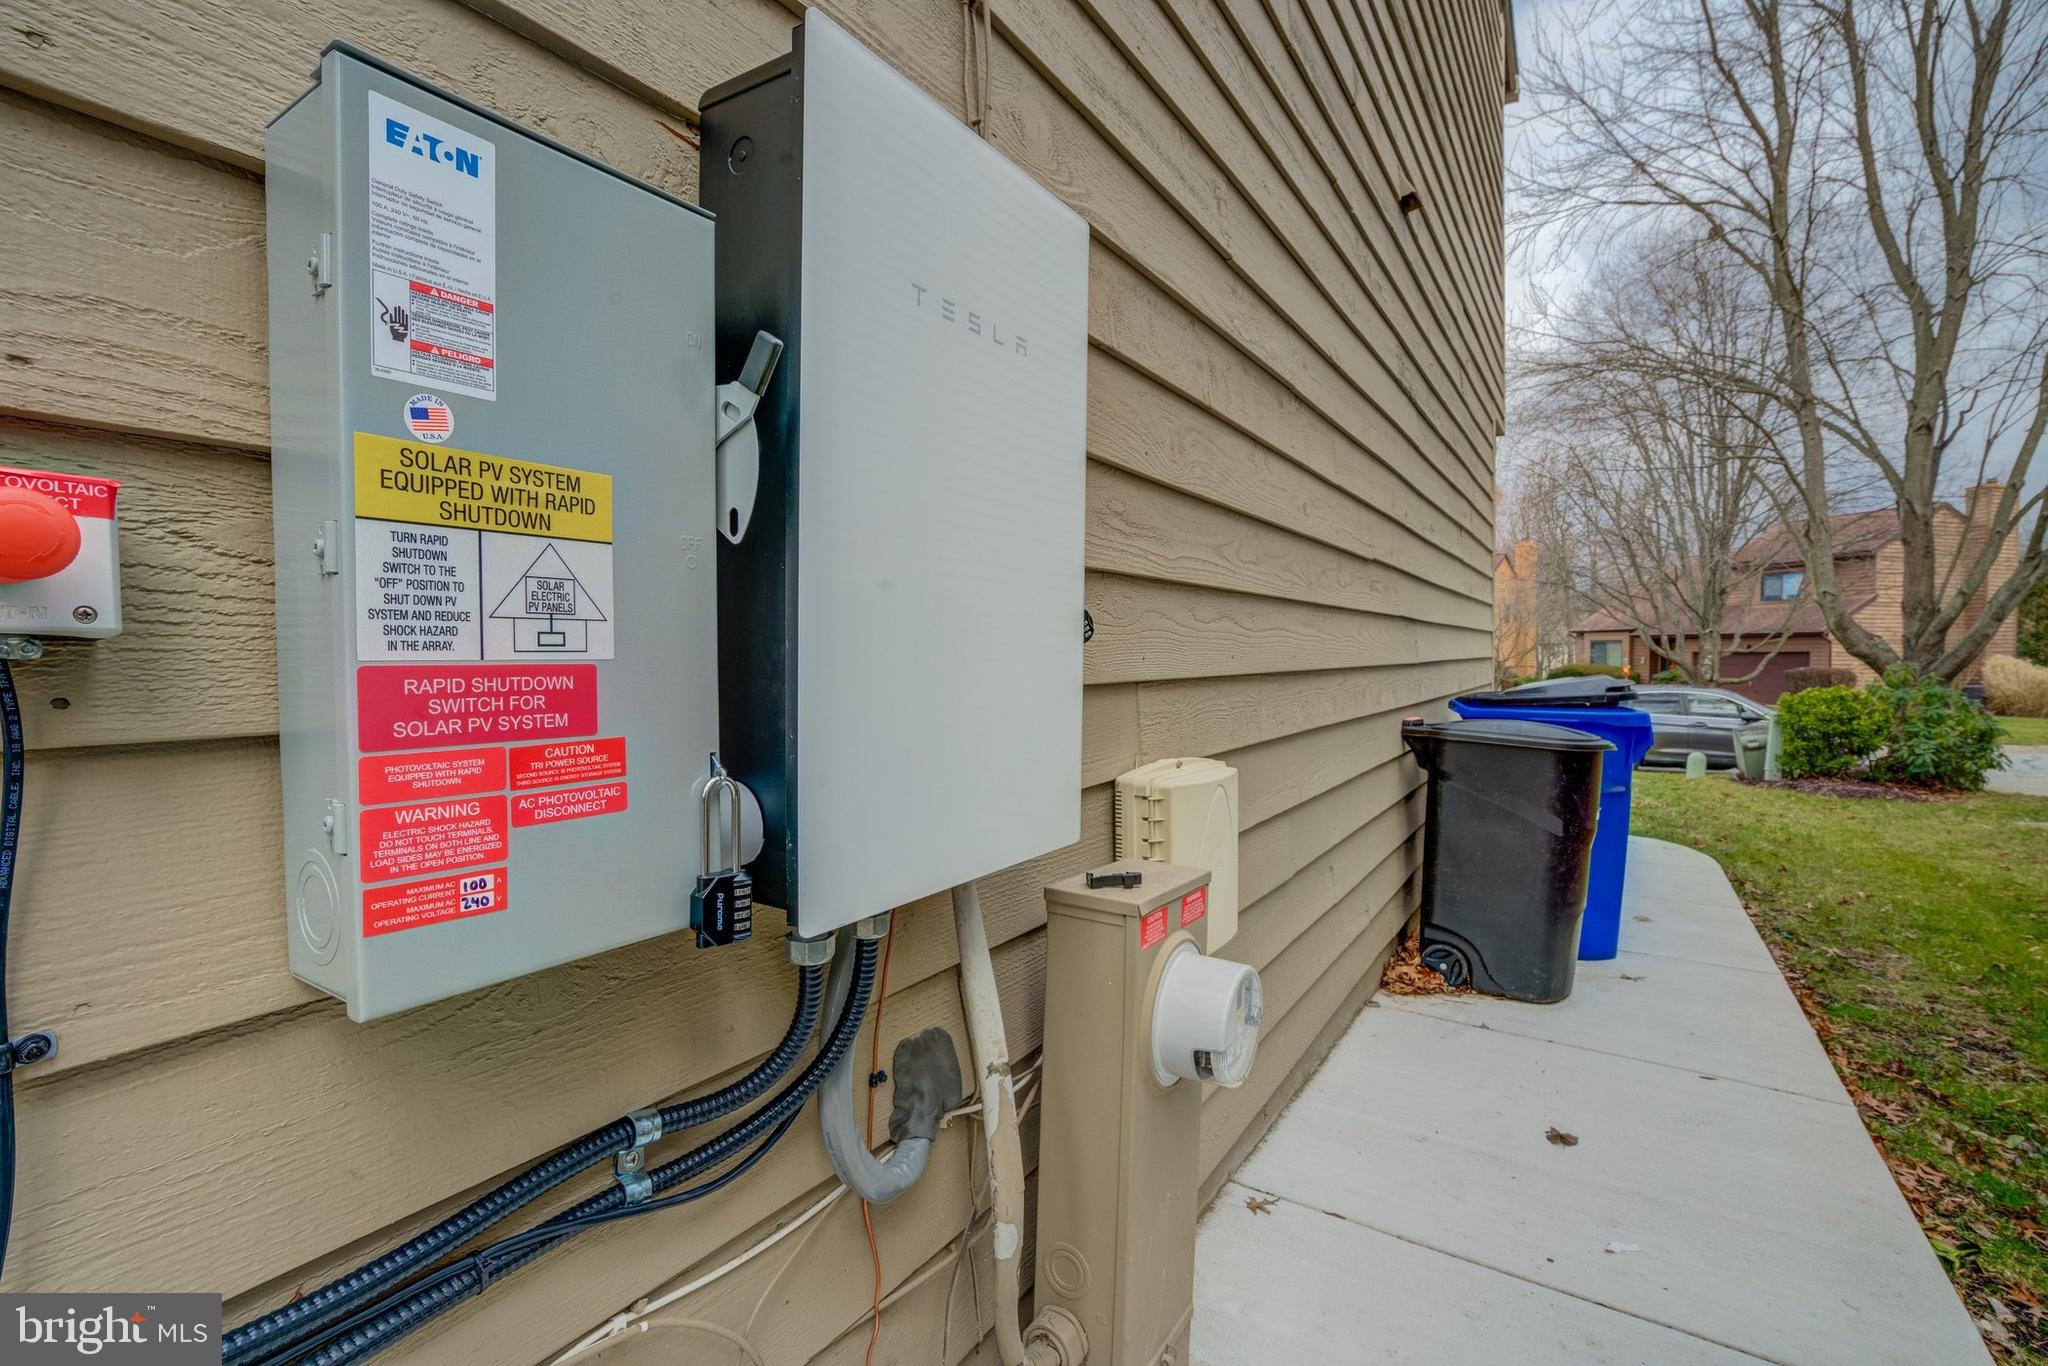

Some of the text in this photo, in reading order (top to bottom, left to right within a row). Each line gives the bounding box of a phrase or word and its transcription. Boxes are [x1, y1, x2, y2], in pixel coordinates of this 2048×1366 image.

[386, 117, 479, 178] EATON
[440, 290, 478, 307] DANGER
[911, 282, 1027, 357] TESLA
[441, 348, 480, 364] PELIGRO
[400, 447, 580, 493] SOLAR PV SYSTEM
[380, 468, 595, 515] EQUIPPED WITH RAPID
[439, 500, 550, 531] SHUTDOWN
[390, 531, 448, 546] TURN RAPID
[392, 546, 447, 561] SHUTDOWN
[382, 561, 456, 577] SWITCH TO THE
[406, 579, 450, 591] POSITION
[452, 581, 464, 592] TO
[536, 580, 564, 591] SOLAR
[383, 593, 456, 606] SHUT DOWN PV
[531, 591, 570, 602] ELECTRIC
[528, 601, 572, 612] PV PANELS
[368, 608, 470, 622] SYSTEM AND REDUCE
[383, 624, 457, 636] SHOCK HAZARD
[387, 640, 454, 650] IN THE ARRAY.
[403, 676, 573, 694] RAPID SHUTDOWN
[3, 692, 16, 711] TYPE
[428, 695, 545, 714] SWITCH FOR
[10, 724, 20, 740] AWG
[393, 713, 568, 738] SOLAR PV SYSTEM
[12, 743, 21, 752] 18
[544, 743, 594, 758] CAUTION
[384, 758, 484, 774] PHOTOVOLTAIC SYSTEM
[530, 754, 608, 769] TRI POWER SOURCE
[566, 764, 601, 772] PHOTOVOLTAIC
[388, 766, 481, 782] EQUIPPED WITH RAPID
[412, 776, 460, 788] SHUTDOWN
[518, 786, 620, 809] AC PHOTOVOLTAIC
[395, 801, 480, 825] WARNING
[534, 799, 606, 819] DISCONNECT
[4, 814, 16, 846] DIGITAL
[382, 817, 490, 840] ELECTRIC SHOCK HAZARD
[373, 832, 498, 859] TERMINALS ON BOTH LINE AND
[379, 840, 392, 849] DO
[395, 837, 413, 847] NOT
[415, 832, 444, 844] TOUCH
[370, 840, 501, 868] LOAD SIDES MAY BE ENERGIZED
[390, 865, 398, 873] IN
[401, 862, 417, 872] THE
[420, 858, 444, 868] OPEN
[406, 882, 443, 895] MAXIMUM
[463, 876, 486, 892] 100
[370, 889, 455, 910] OPERATING CURRENT
[406, 898, 456, 913] MAXIMUM AC
[461, 893, 489, 910] 240
[373, 906, 456, 928] OPERATING VOLTAGE
